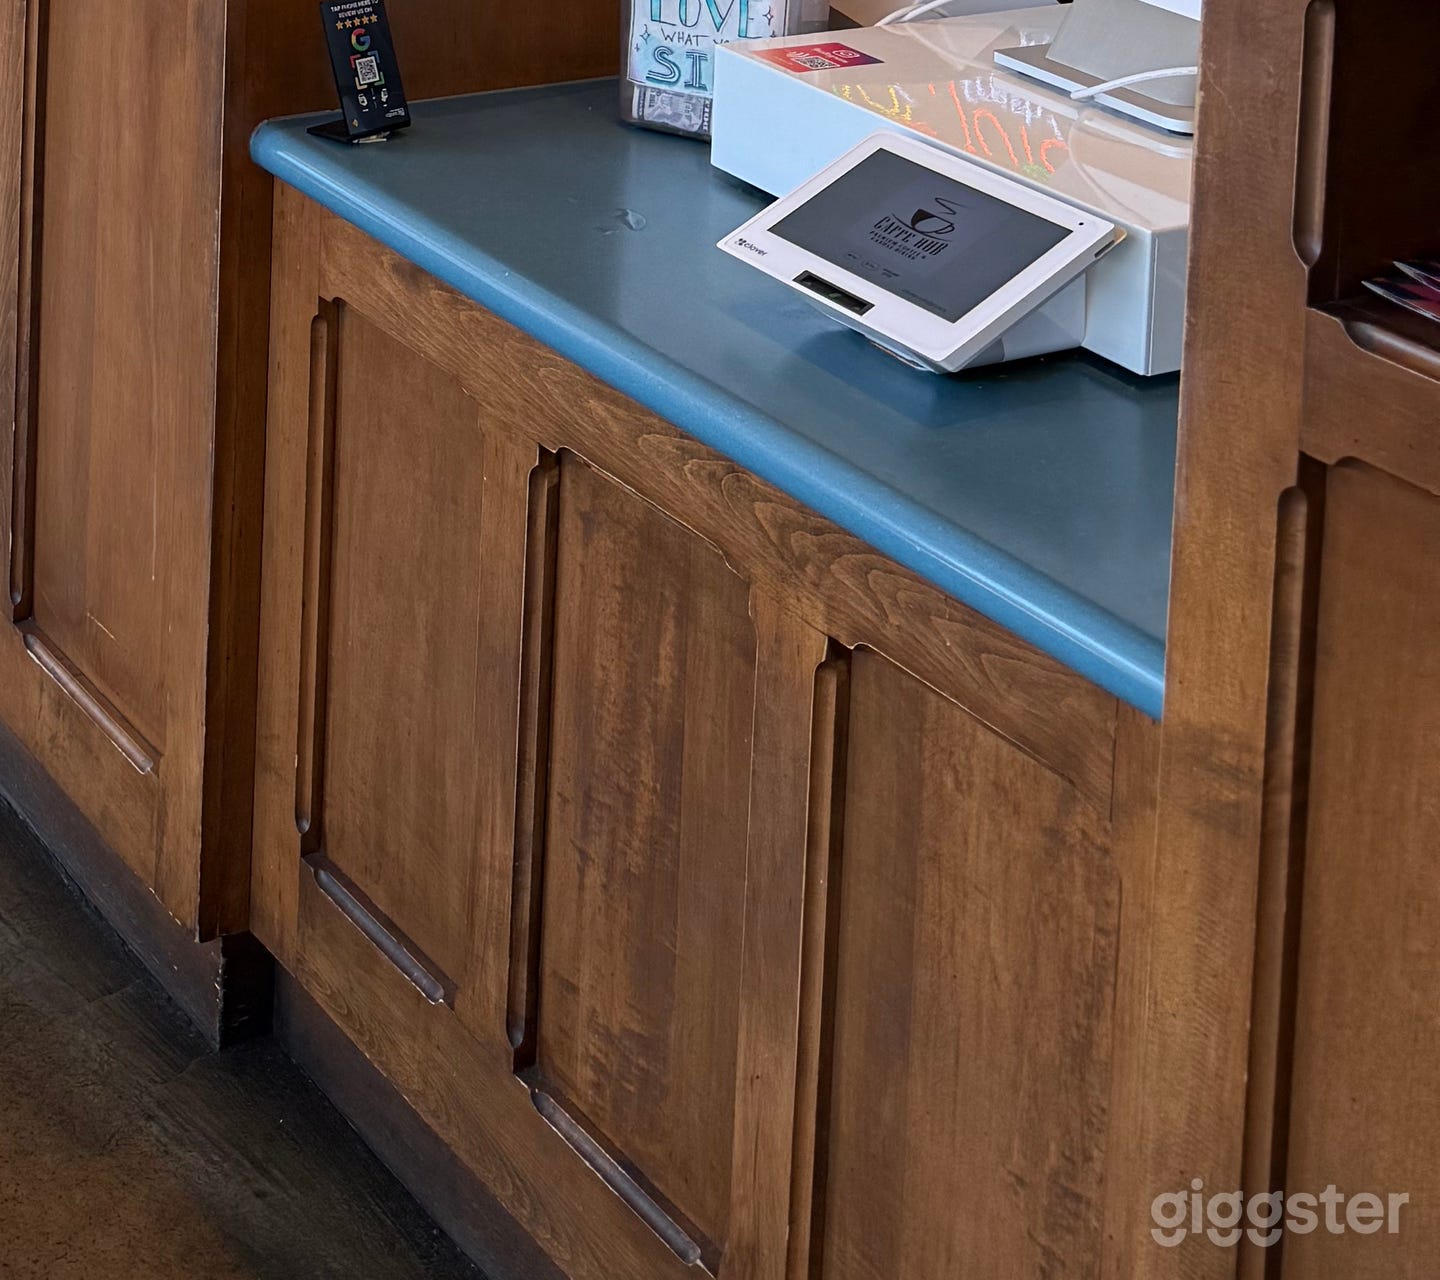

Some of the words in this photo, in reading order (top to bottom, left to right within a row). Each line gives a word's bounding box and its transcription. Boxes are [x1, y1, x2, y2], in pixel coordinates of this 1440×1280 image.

[659, 27, 710, 48] WHAT
[744, 244, 768, 256] clover
[913, 238, 949, 256] HUB
